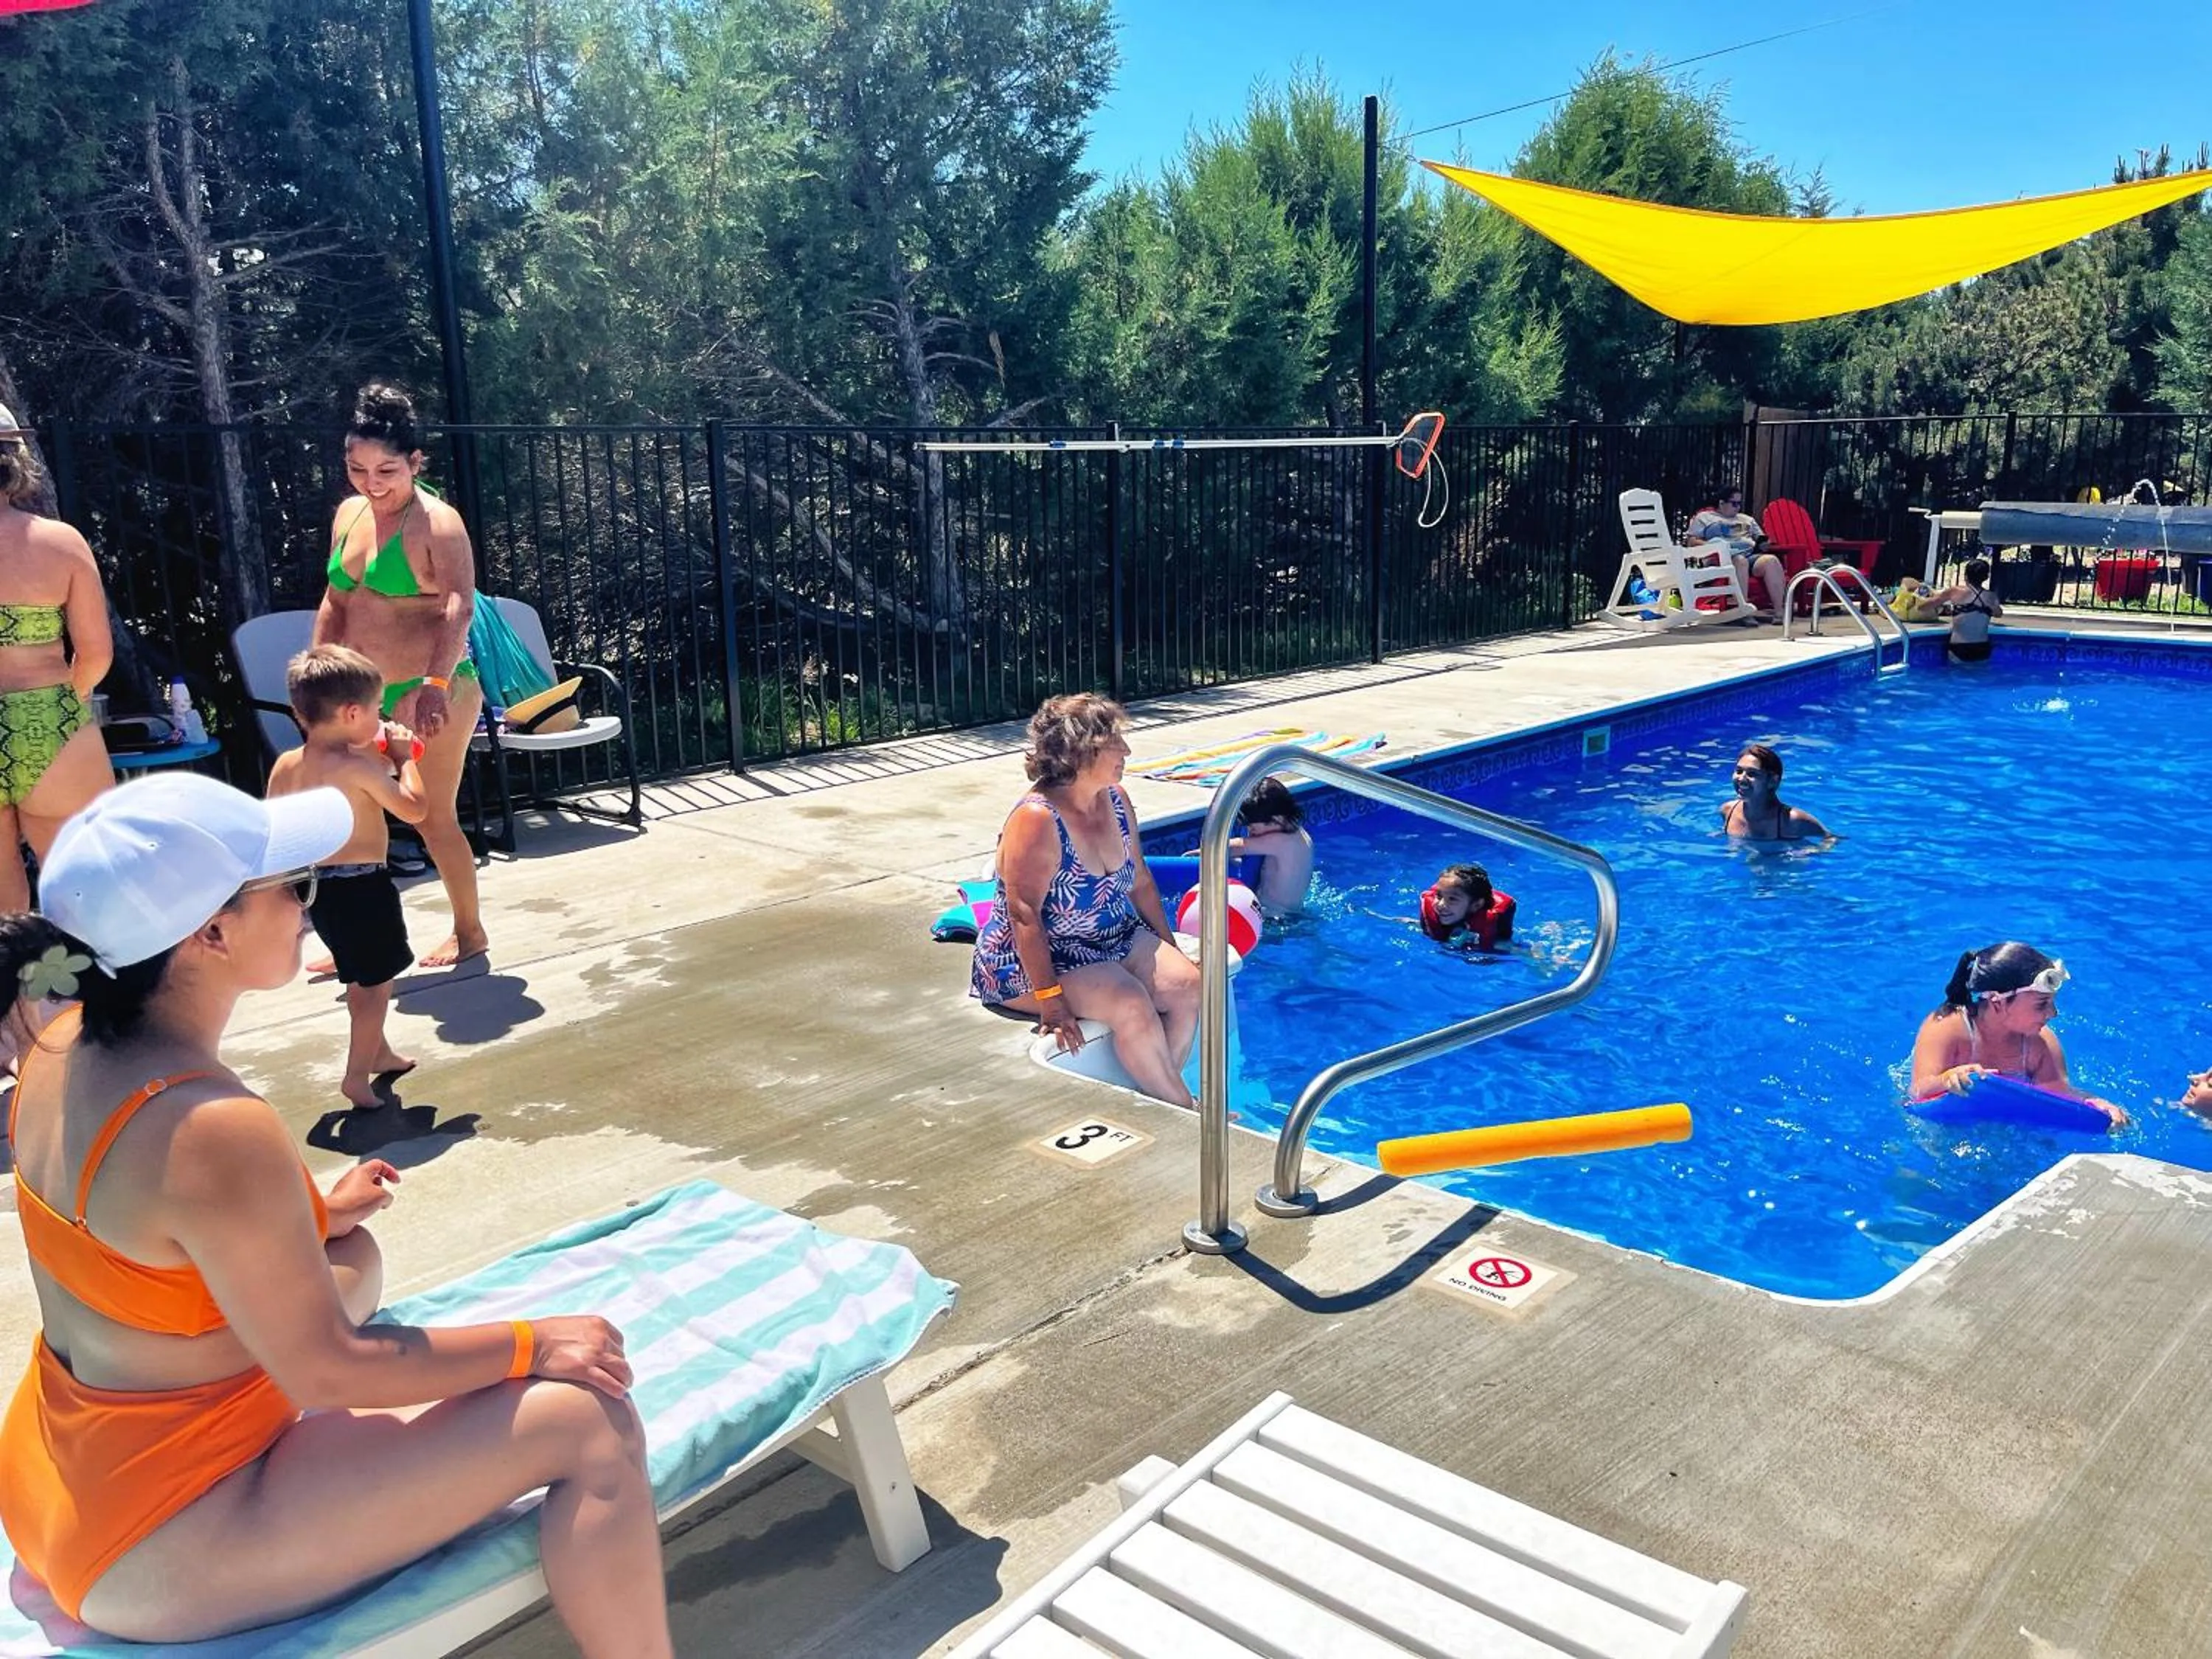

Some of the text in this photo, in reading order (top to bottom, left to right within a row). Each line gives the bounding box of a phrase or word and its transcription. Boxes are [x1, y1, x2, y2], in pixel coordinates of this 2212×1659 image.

[1056, 1125, 1133, 1149] 3 FT
[1449, 1278, 1506, 1301] NO DIVING
